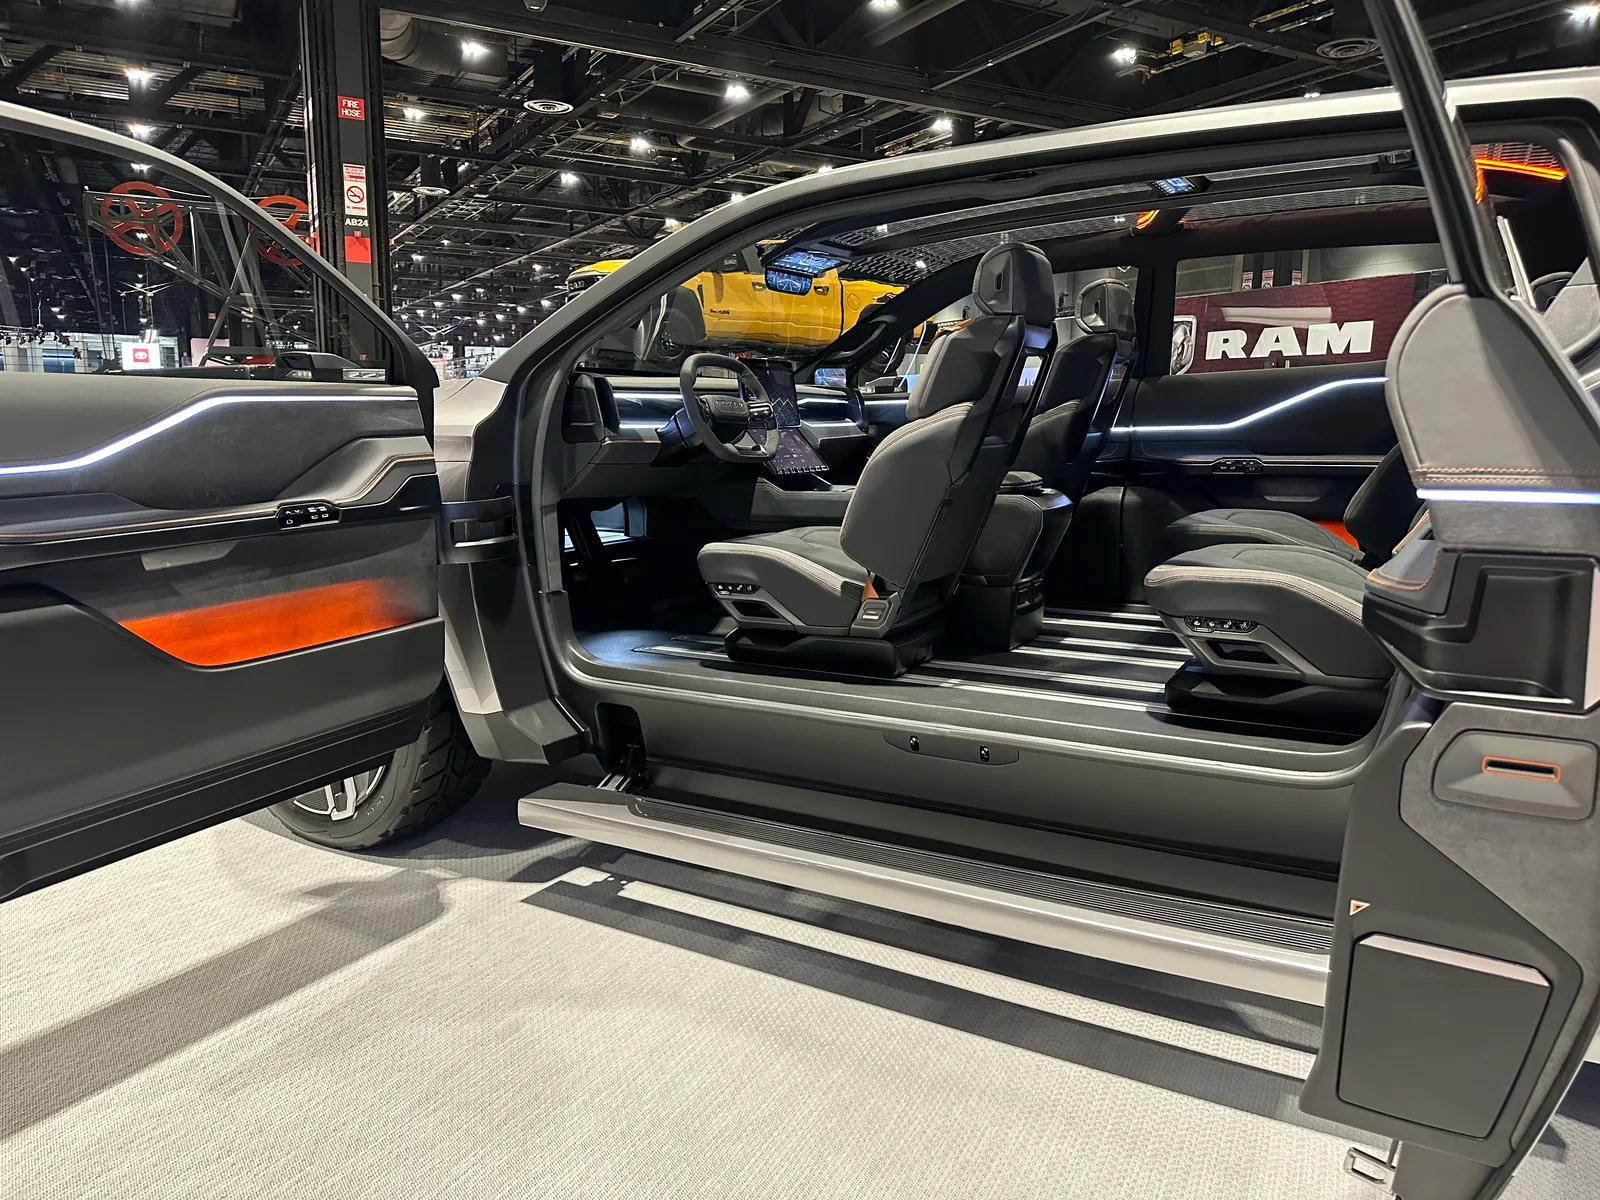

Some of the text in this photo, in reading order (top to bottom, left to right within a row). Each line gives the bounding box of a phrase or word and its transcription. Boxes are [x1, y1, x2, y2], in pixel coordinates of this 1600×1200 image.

[342, 99, 359, 108] FIRE
[341, 108, 361, 117] HOSE
[345, 218, 369, 227] AB24
[1205, 320, 1374, 360] RAM
